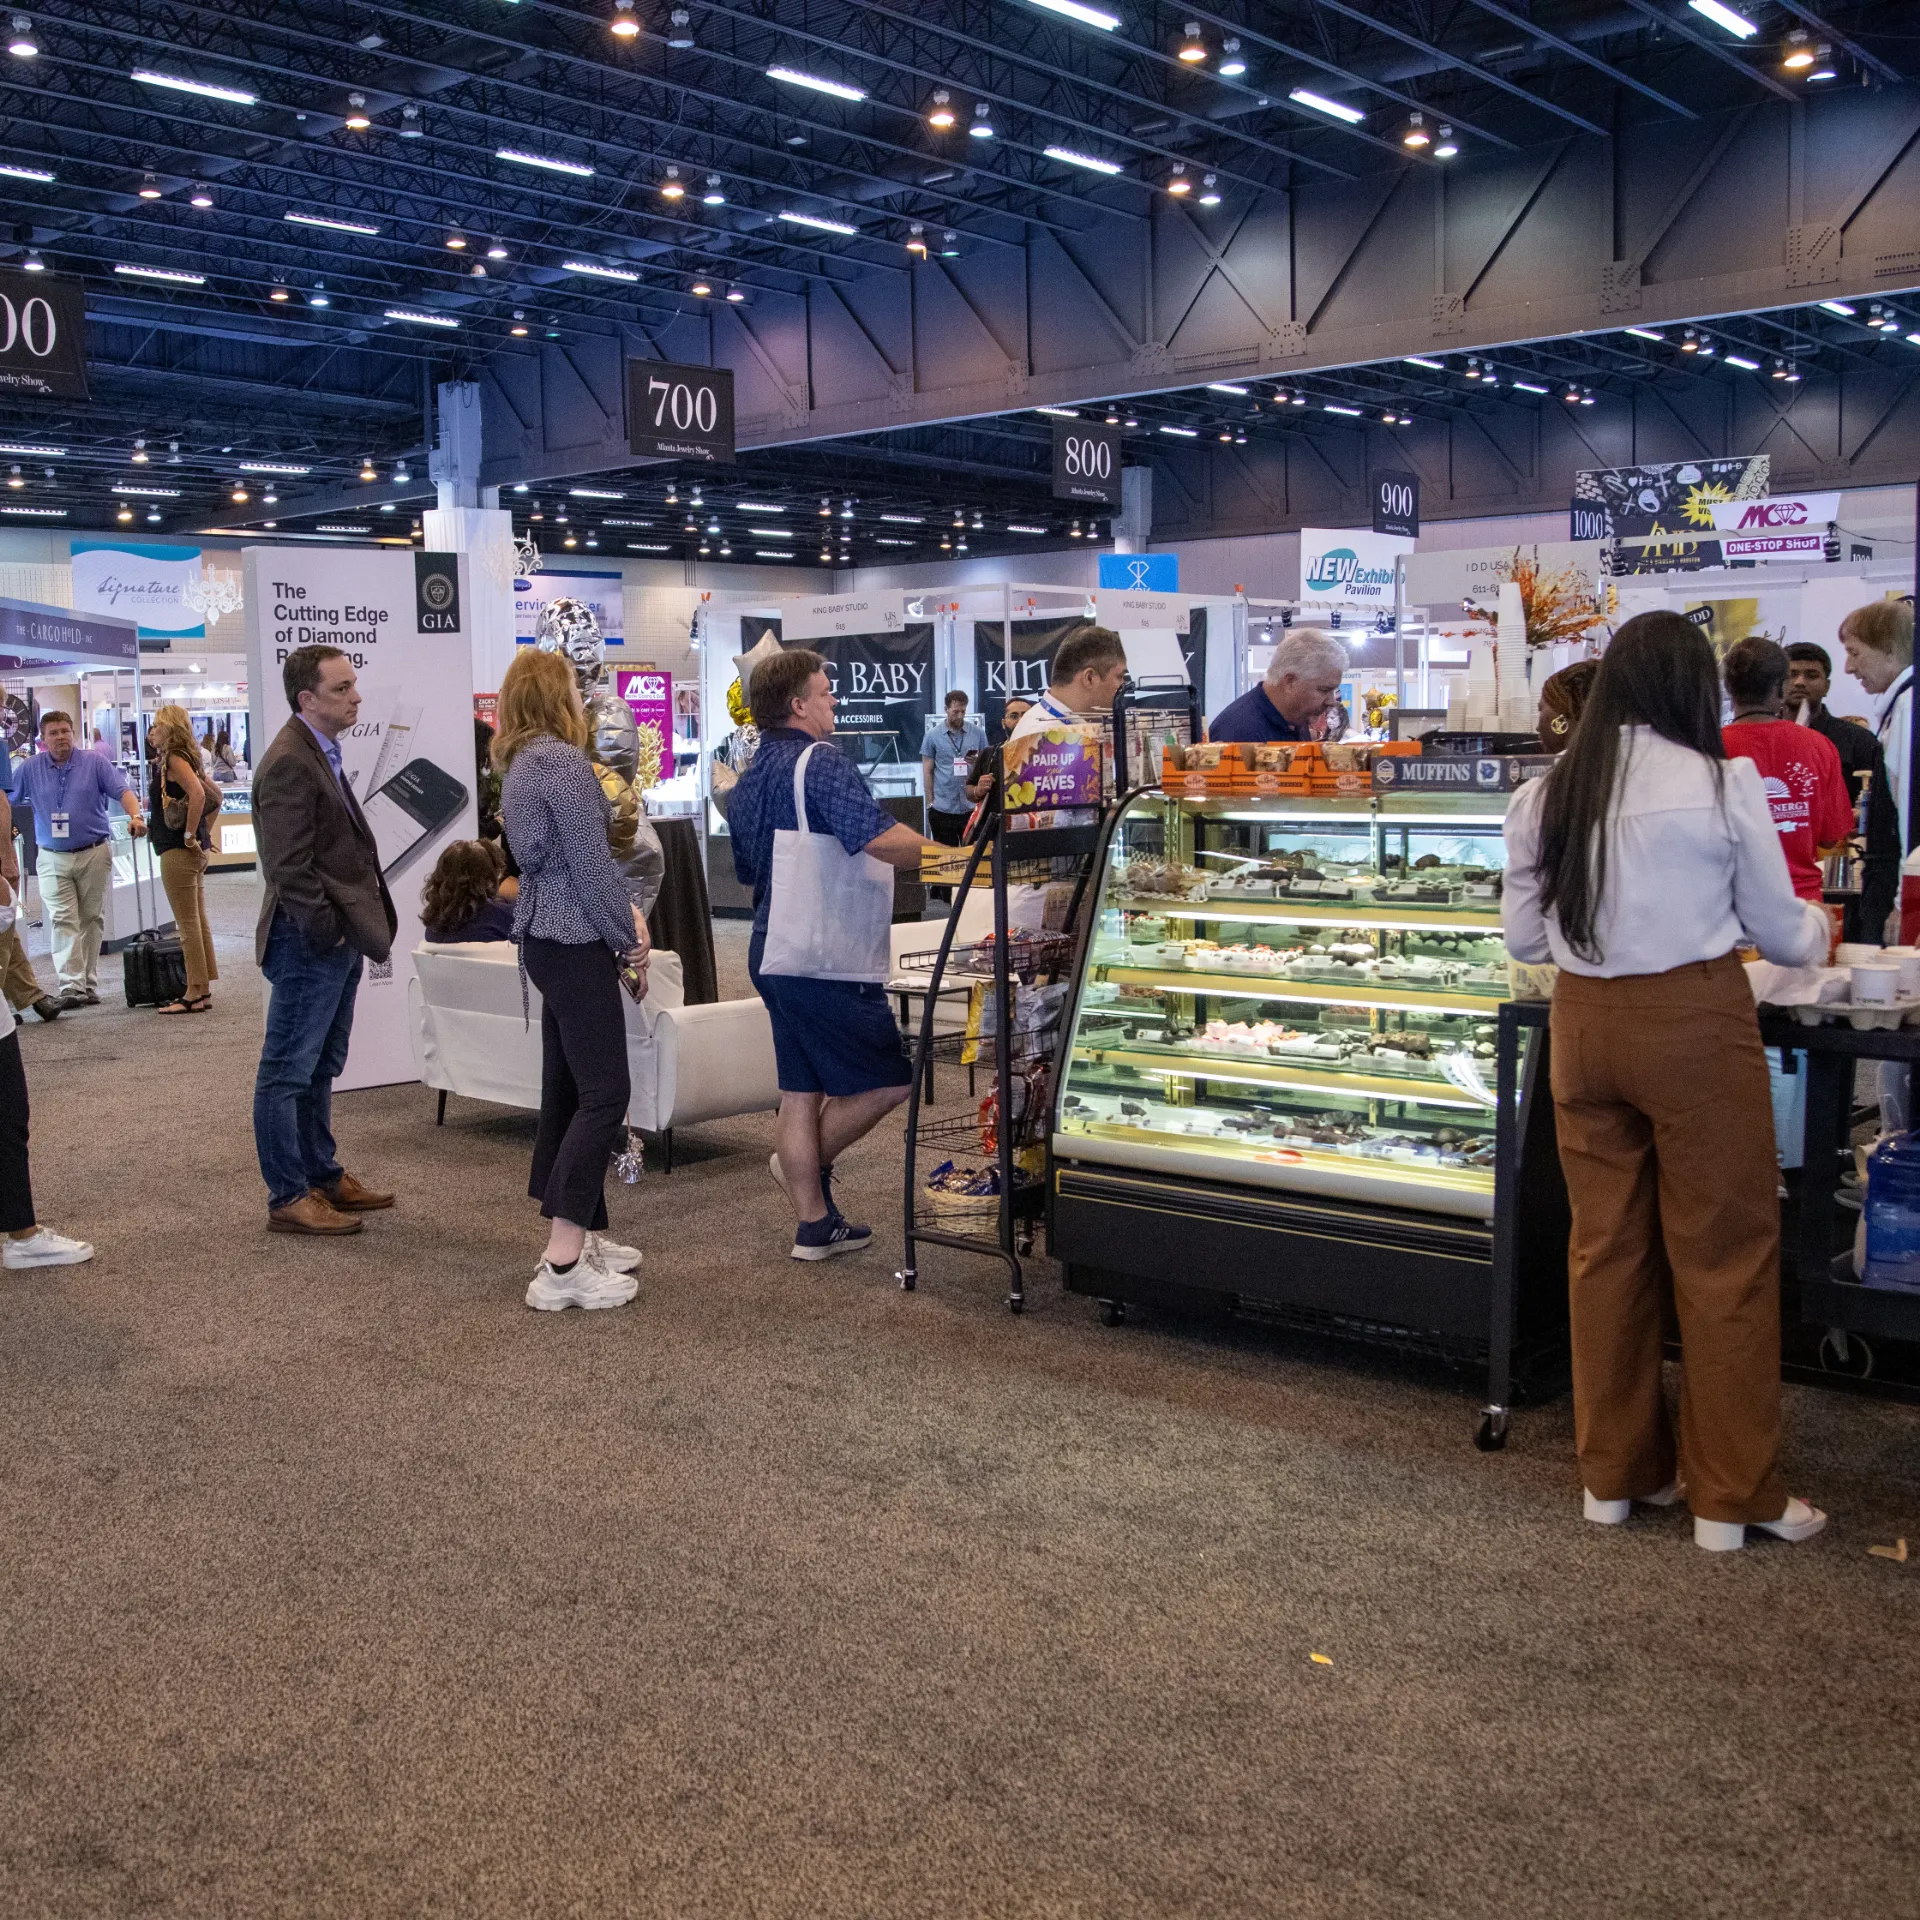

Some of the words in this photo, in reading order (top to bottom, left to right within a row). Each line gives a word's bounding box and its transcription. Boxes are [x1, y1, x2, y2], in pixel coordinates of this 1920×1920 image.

[21, 375, 45, 386] Show
[648, 375, 717, 432] 700
[656, 442, 676, 452] Atlanta
[676, 444, 695, 455] Jewelry
[695, 446, 710, 454] Show
[1066, 436, 1110, 478] 800
[1382, 482, 1412, 516] 900
[1573, 510, 1603, 539] 1000
[1729, 540, 1783, 552] ONE-STOP
[1786, 538, 1817, 549] SHOP
[1306, 556, 1359, 582] NEW
[98, 576, 180, 605] Signature
[272, 582, 306, 598] The
[1345, 584, 1381, 596] Pavilion
[812, 606, 828, 614] KING
[828, 605, 844, 613] BABY
[846, 602, 868, 612] STUDIO
[1123, 600, 1135, 609] KING
[1149, 602, 1166, 610] STUDIO
[274, 604, 339, 625] Cutting
[344, 606, 389, 625] Edge
[422, 613, 455, 628] GIA
[16, 626, 26, 636] THE
[30, 622, 60, 642] CARGO
[836, 622, 846, 630] 615
[275, 628, 292, 643] of
[298, 627, 377, 644] Diamond
[849, 660, 927, 694] BABY
[984, 659, 1050, 692] KIN
[840, 714, 883, 724] ACCESSORIES
[351, 722, 380, 738] GIA
[1032, 754, 1058, 766] PAIR
[1060, 752, 1075, 766] UP
[1402, 763, 1470, 781] MUFFINS
[1034, 774, 1076, 791] FAVES
